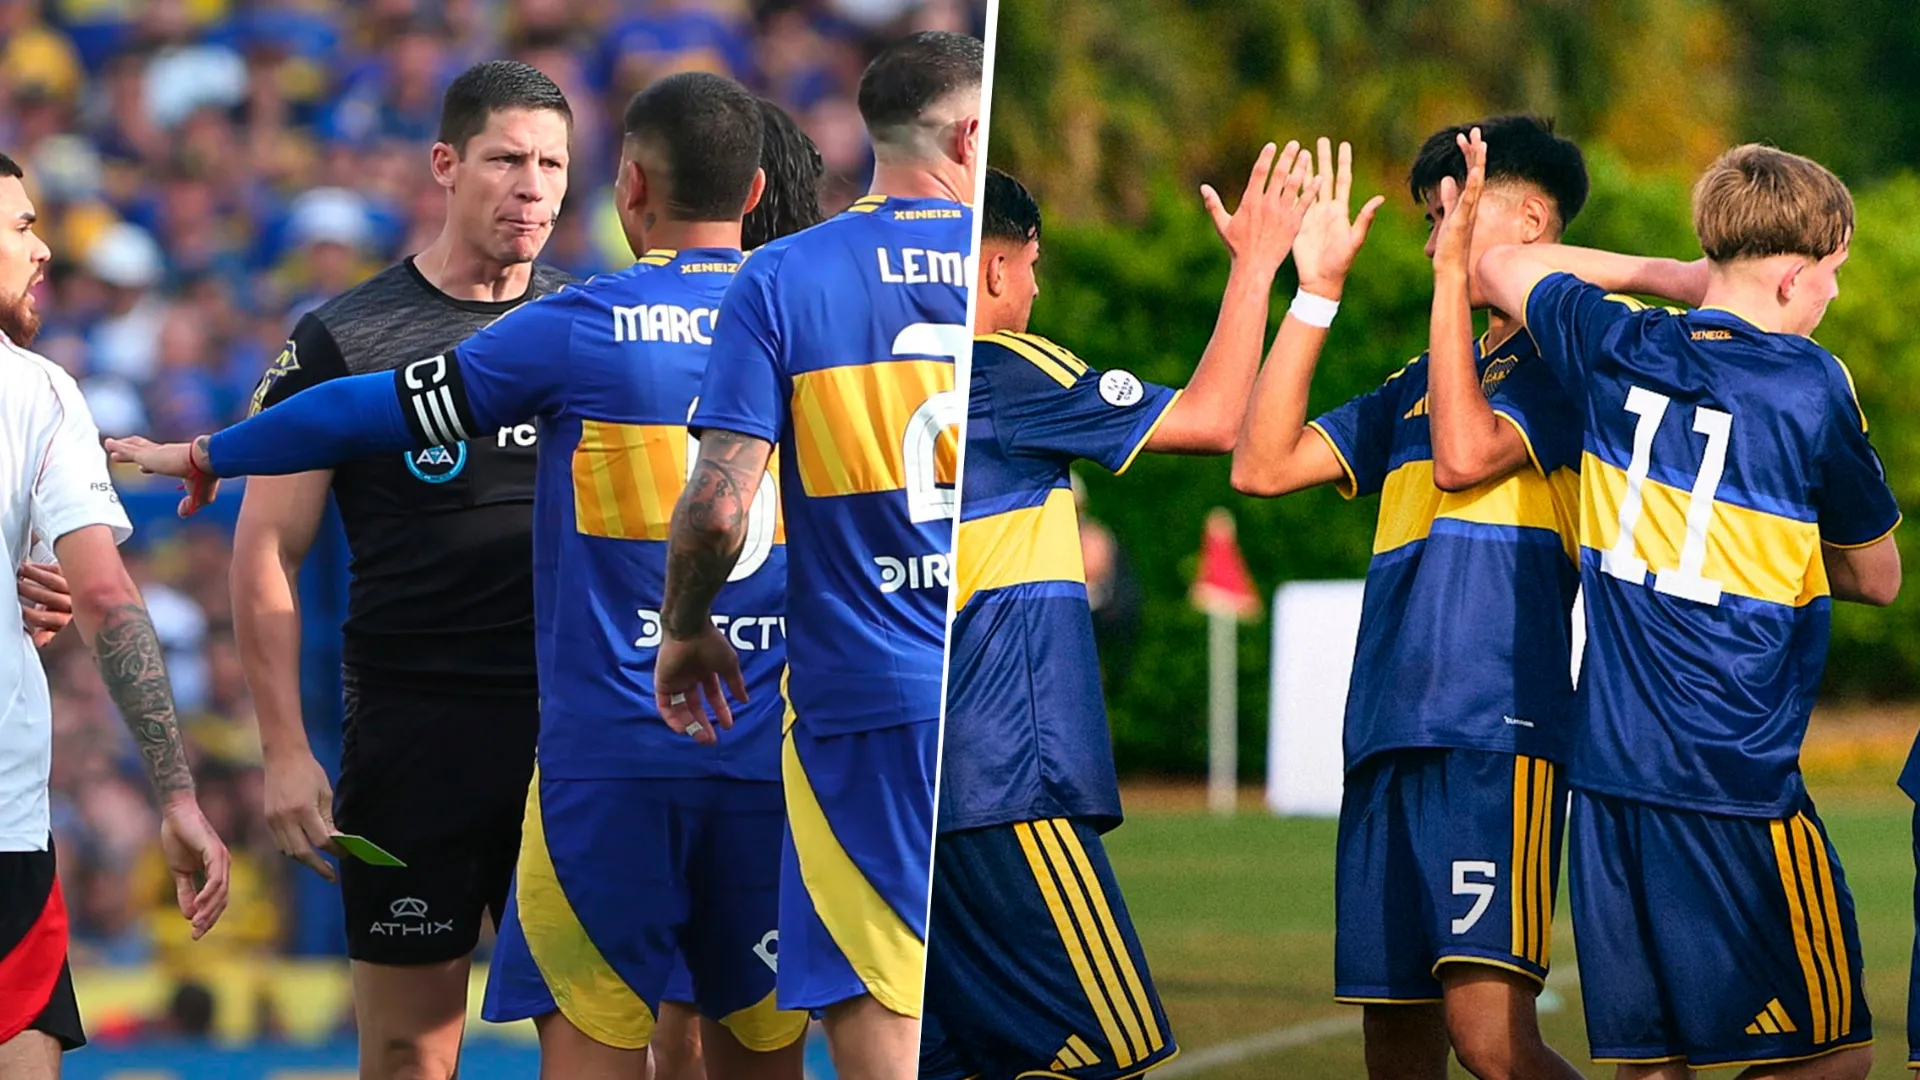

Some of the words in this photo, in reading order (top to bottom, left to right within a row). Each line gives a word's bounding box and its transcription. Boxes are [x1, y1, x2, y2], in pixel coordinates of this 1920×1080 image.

[893, 209, 963, 221] XENEIZE
[681, 262, 740, 274] XENEIZ
[1600, 385, 1733, 607] 11
[873, 553, 952, 593] DIR
[1451, 861, 1496, 935] 5
[369, 918, 454, 936] ATHIX
